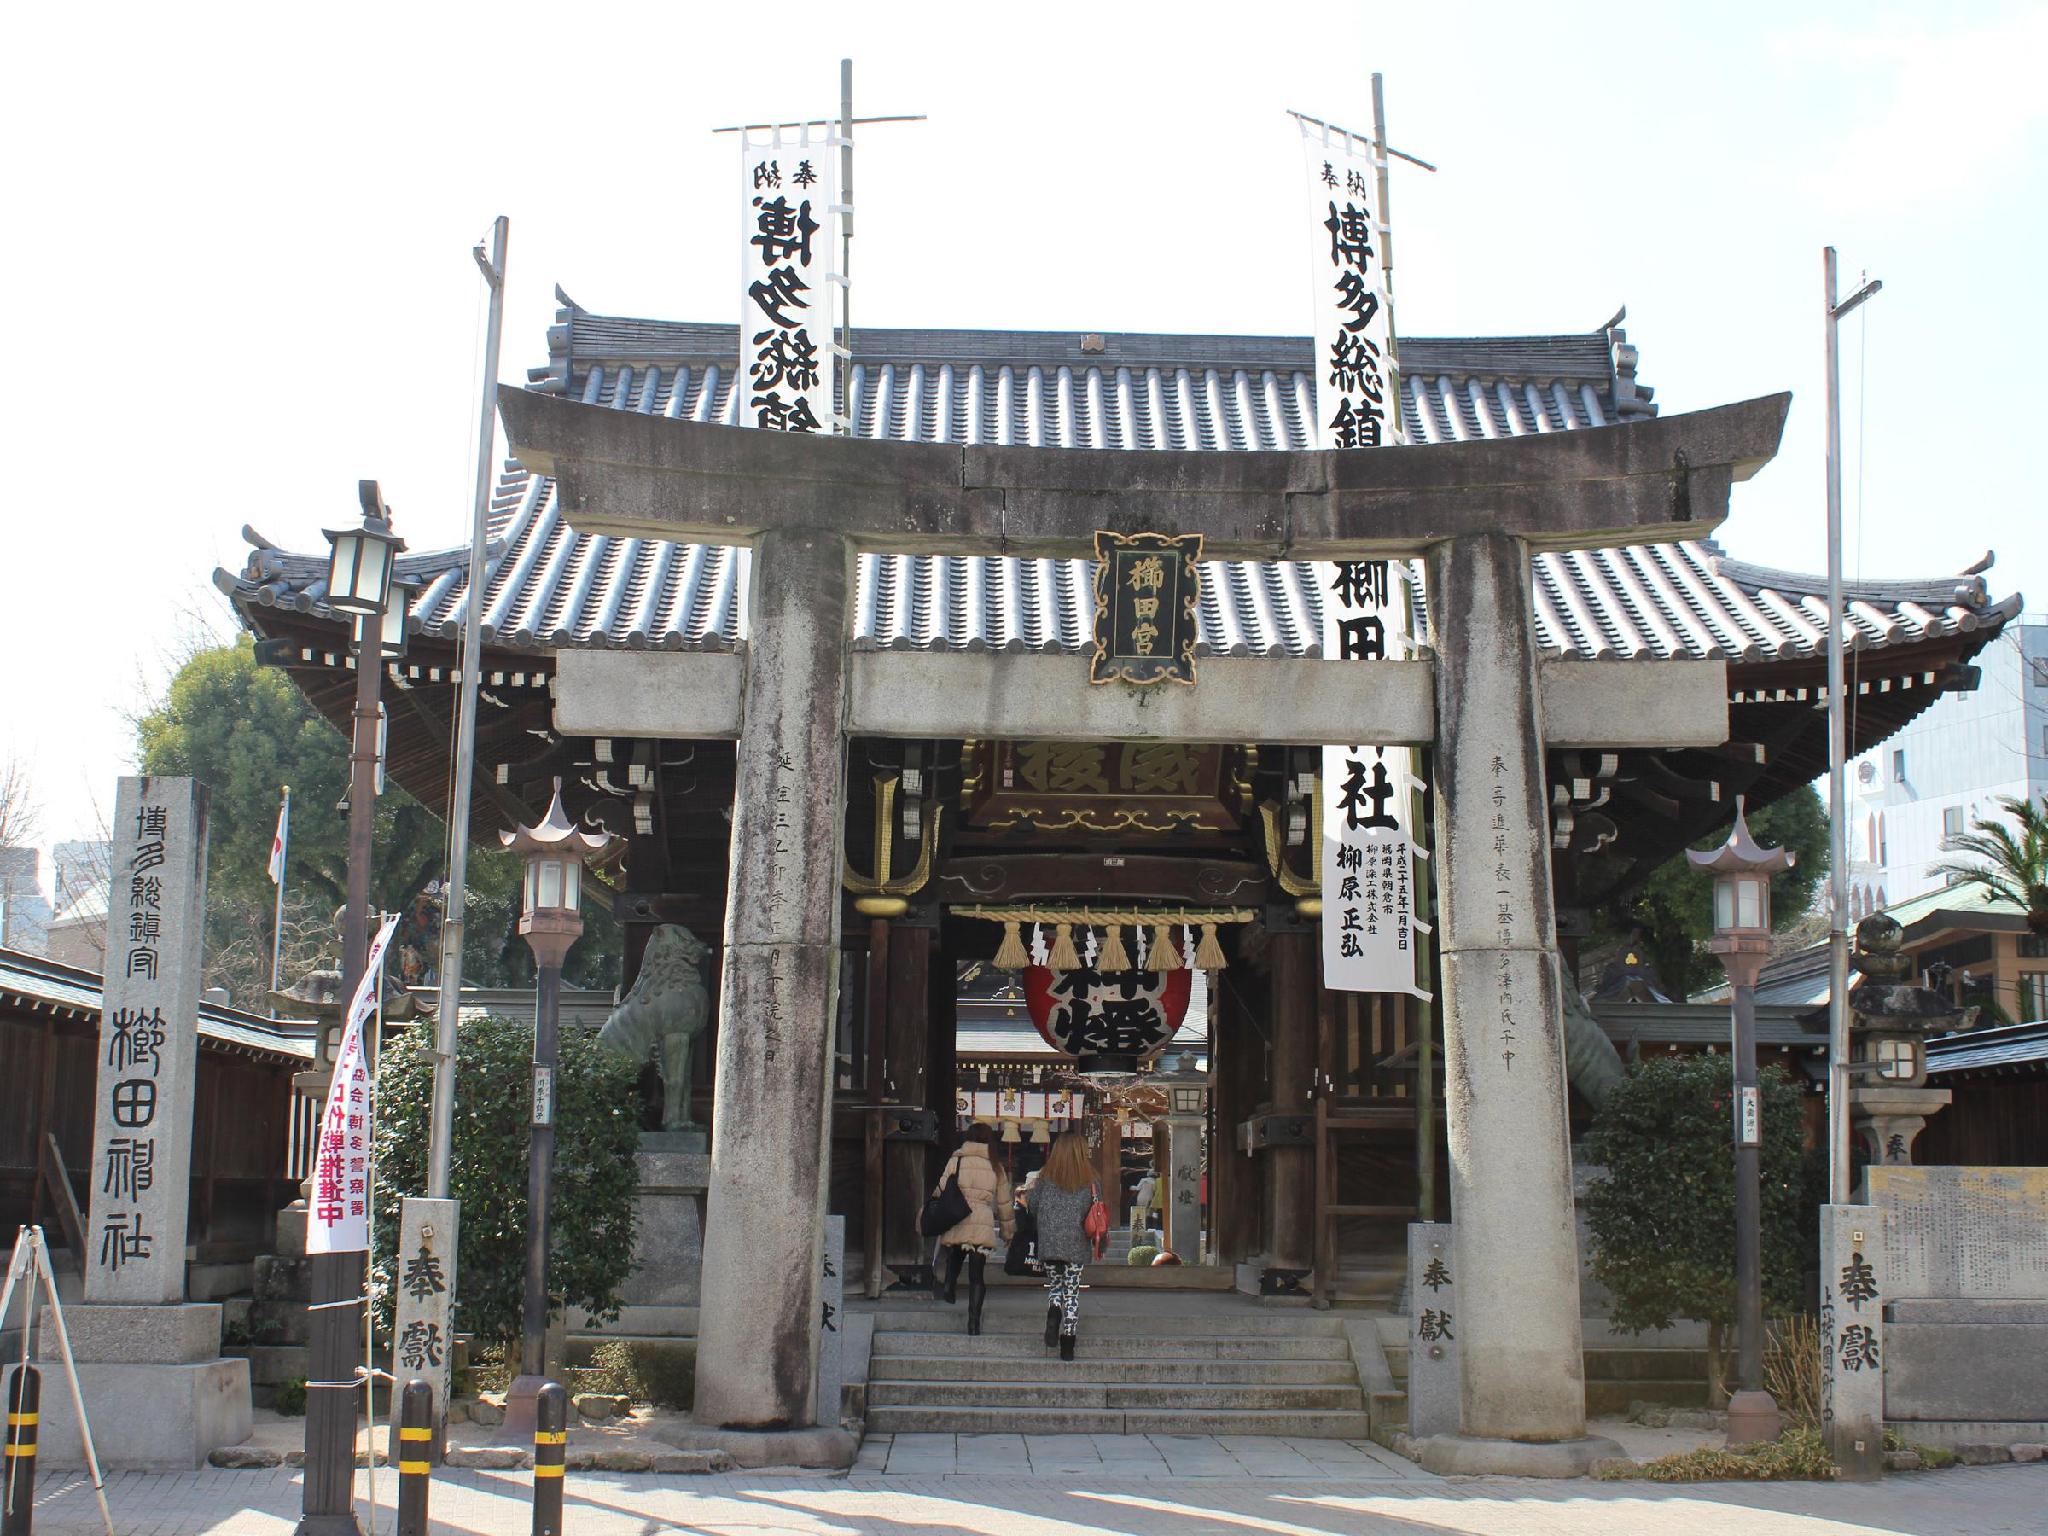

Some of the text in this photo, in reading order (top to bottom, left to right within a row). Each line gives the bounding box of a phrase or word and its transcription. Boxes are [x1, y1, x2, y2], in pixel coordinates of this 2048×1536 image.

[1321, 159, 1367, 201] 奉納
[1338, 746, 1400, 832] 社
[1381, 844, 1394, 915] 福岡県朝倉市
[1396, 843, 1409, 950] 平成二十五年一月吉日
